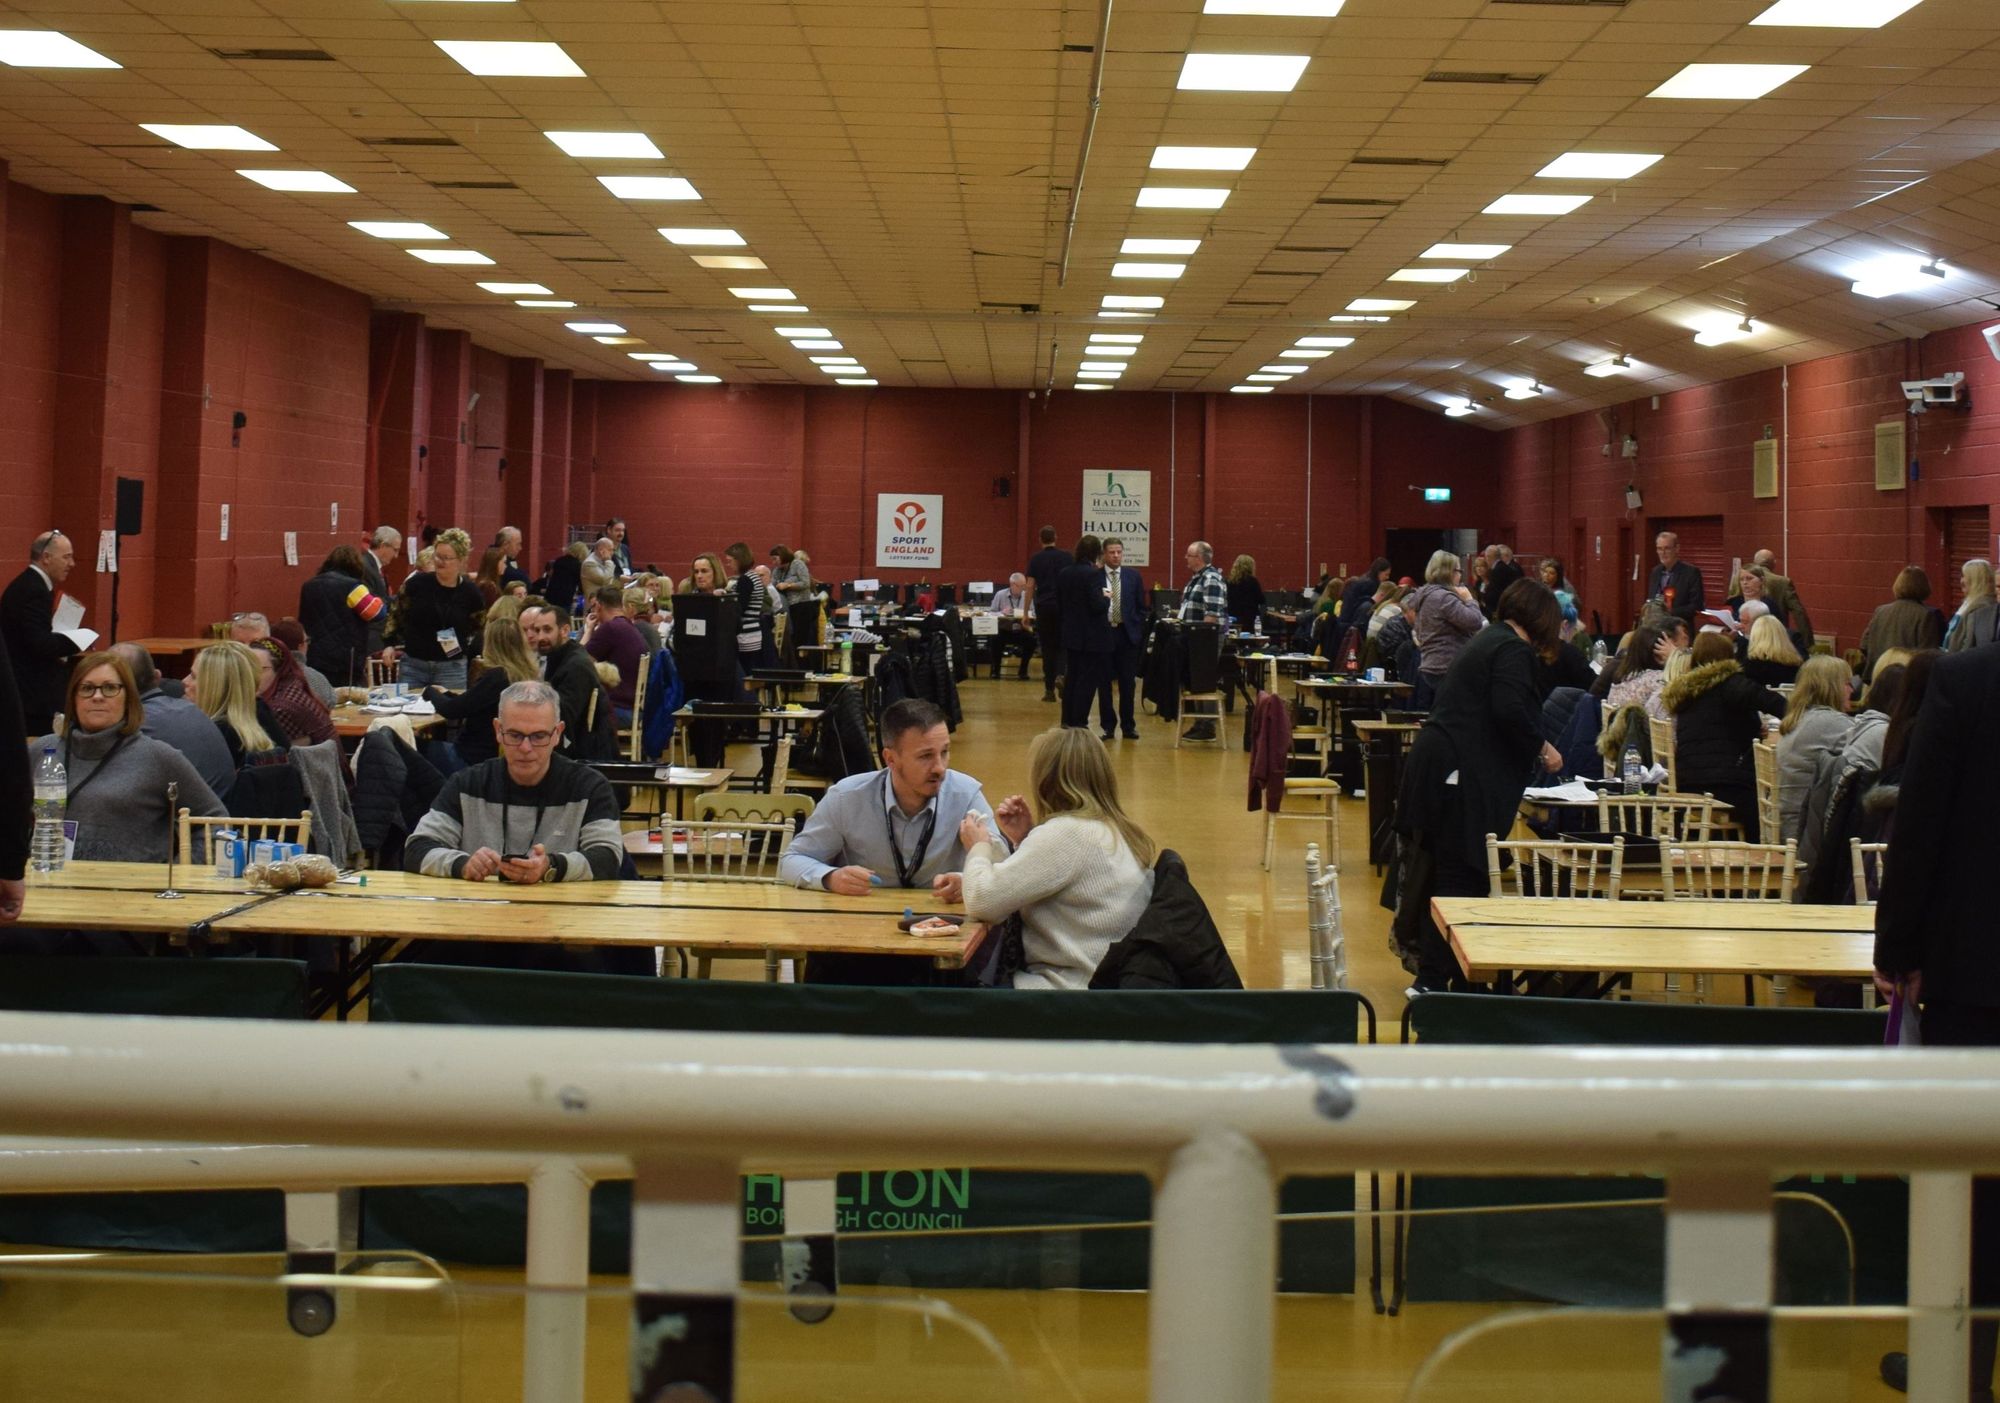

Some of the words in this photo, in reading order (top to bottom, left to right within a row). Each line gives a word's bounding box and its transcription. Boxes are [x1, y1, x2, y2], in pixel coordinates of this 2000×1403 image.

[1093, 499, 1140, 507] HALTON
[1084, 521, 1149, 533] HALTON
[884, 546, 935, 554] ENGLAND
[746, 1167, 970, 1209] HTON
